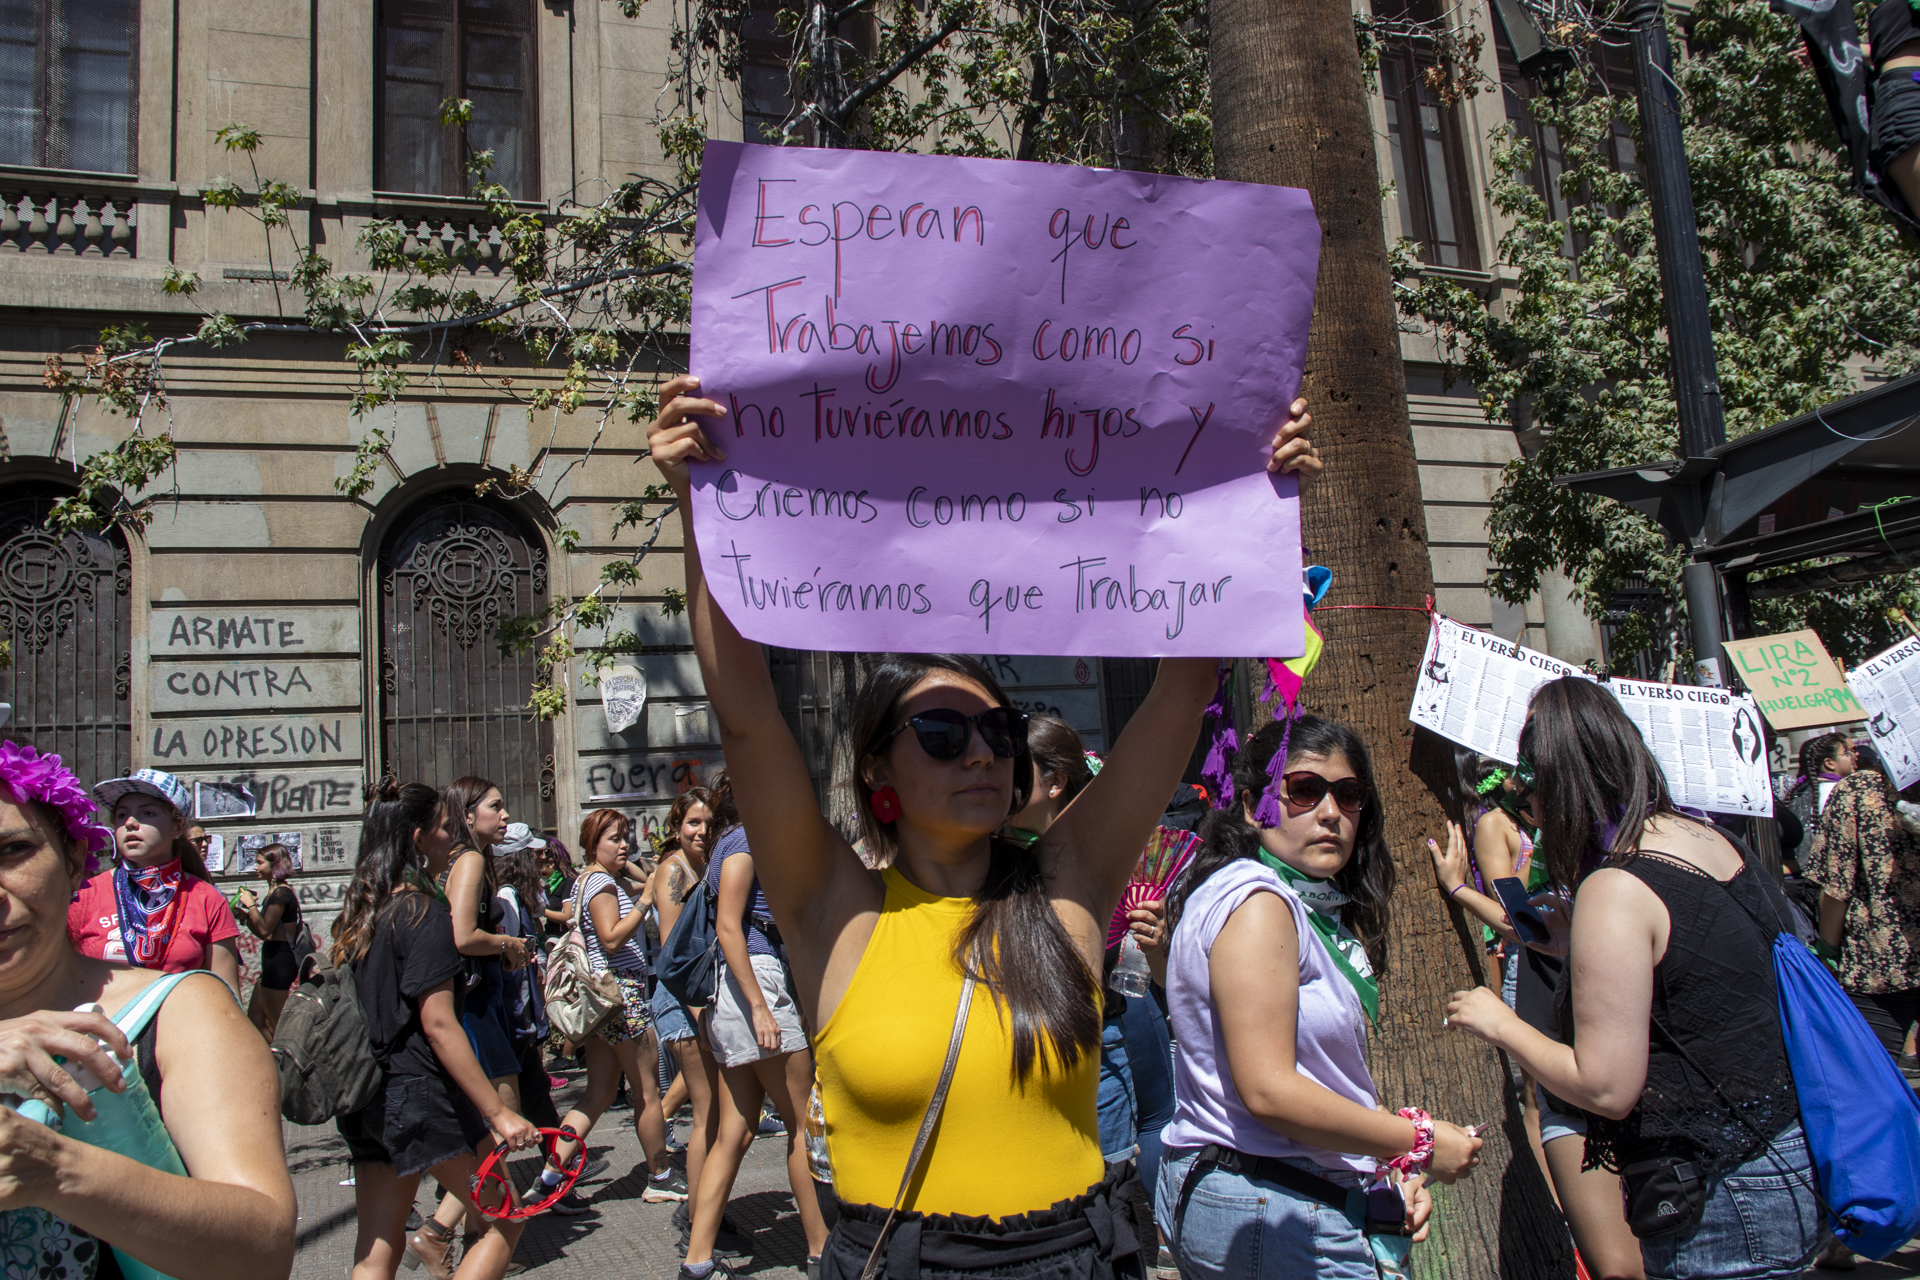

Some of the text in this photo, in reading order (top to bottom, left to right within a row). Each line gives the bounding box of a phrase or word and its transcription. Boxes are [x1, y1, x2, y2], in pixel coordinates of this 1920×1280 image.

[752, 178, 1138, 308] Esperan que
[731, 276, 1003, 394] Trabajemos
[1041, 387, 1142, 477] hijos
[716, 467, 879, 525] Criemos
[1140, 485, 1184, 520] no
[969, 577, 1045, 635] que
[1059, 556, 1233, 641] Trabajar
[168, 614, 305, 650] ARMATE
[1460, 630, 1573, 677] EL VERSO CIEGO
[1736, 639, 1819, 675] LIRA
[1865, 662, 1885, 677] EL
[166, 665, 313, 698] CONTRA
[1619, 683, 1731, 706] EL VERSO CIEGO
[1758, 692, 1829, 715] HUELGA
[153, 719, 342, 760] LA OPRESION
[586, 761, 693, 798] Fuera
